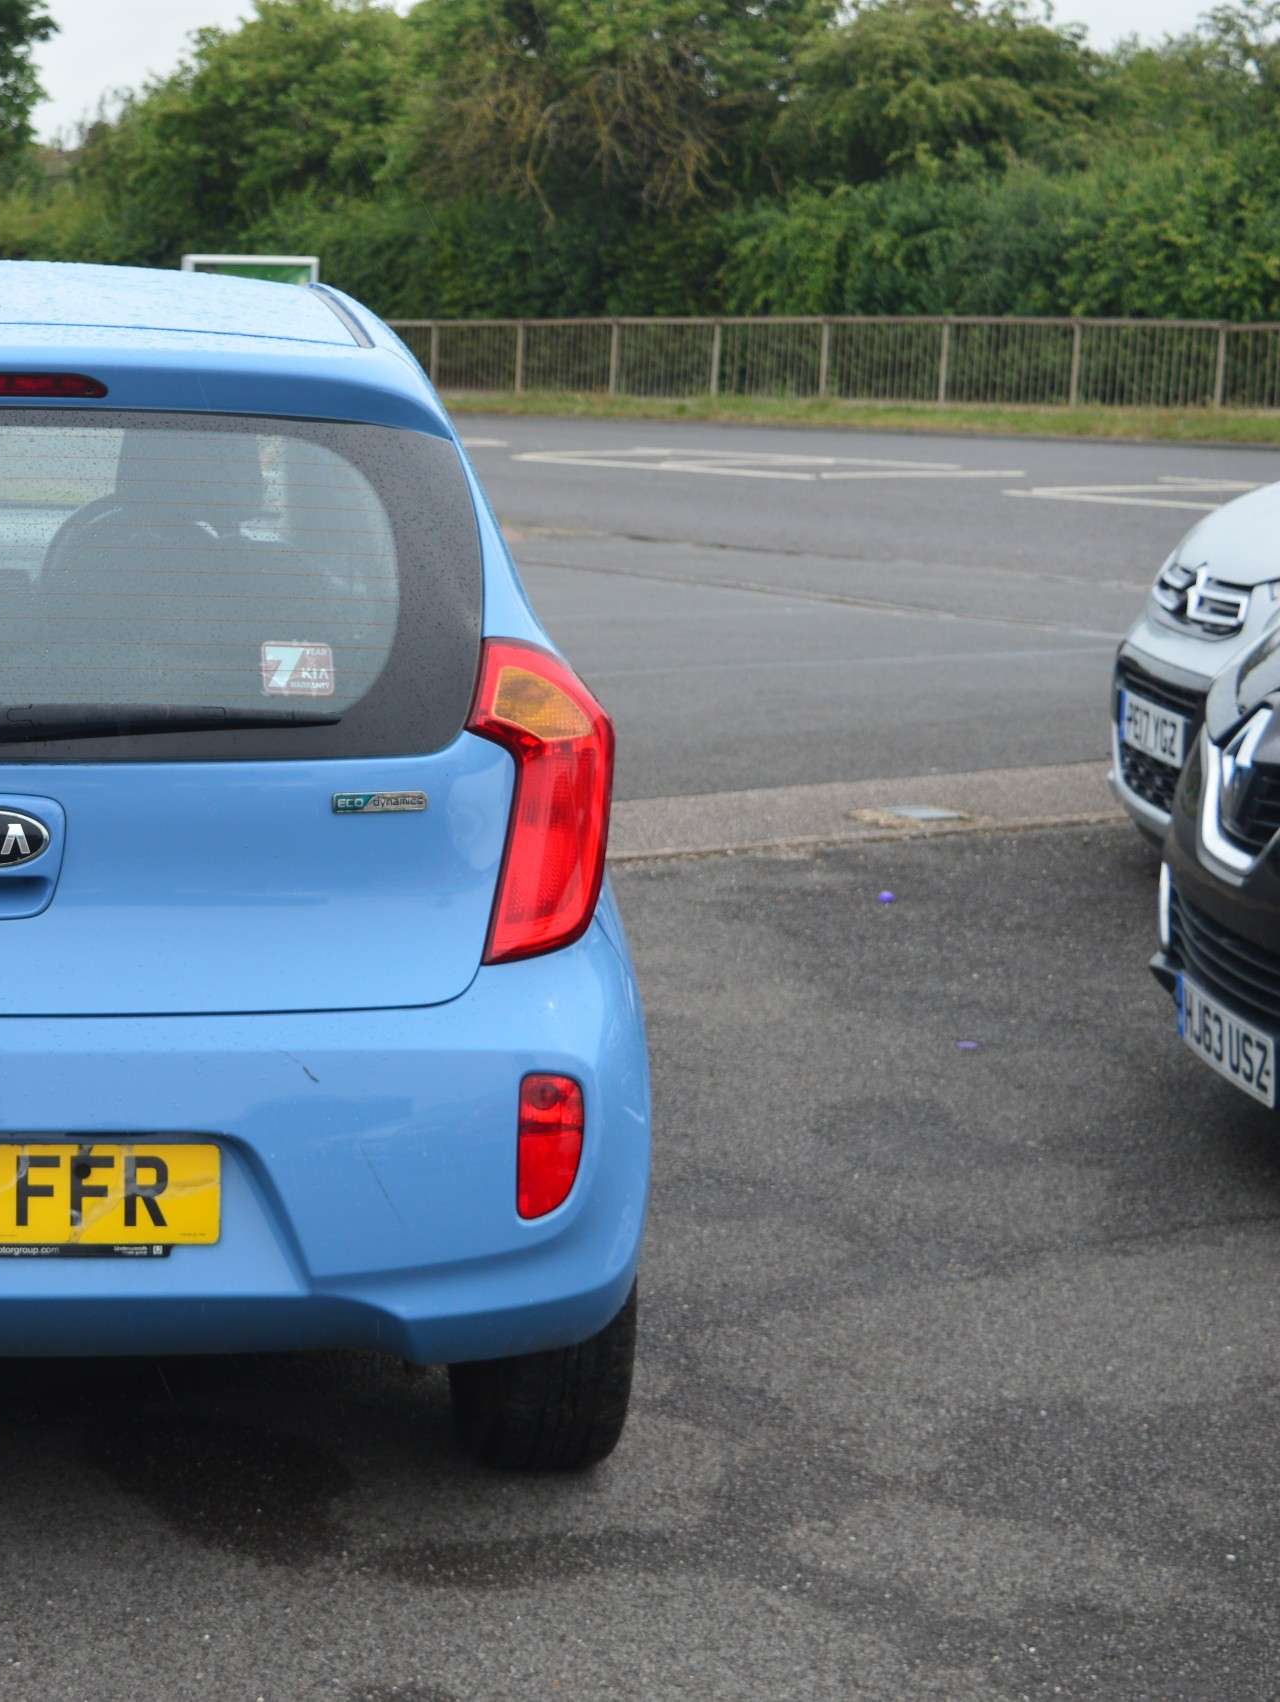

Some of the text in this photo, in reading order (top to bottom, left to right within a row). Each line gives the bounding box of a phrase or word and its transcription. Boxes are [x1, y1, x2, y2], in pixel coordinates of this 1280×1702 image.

[302, 668, 330, 679] KIA
[337, 794, 424, 809] ECO dynamics
[1184, 987, 1269, 1095] HJ63 USZ
[16, 1154, 170, 1228] FFR
